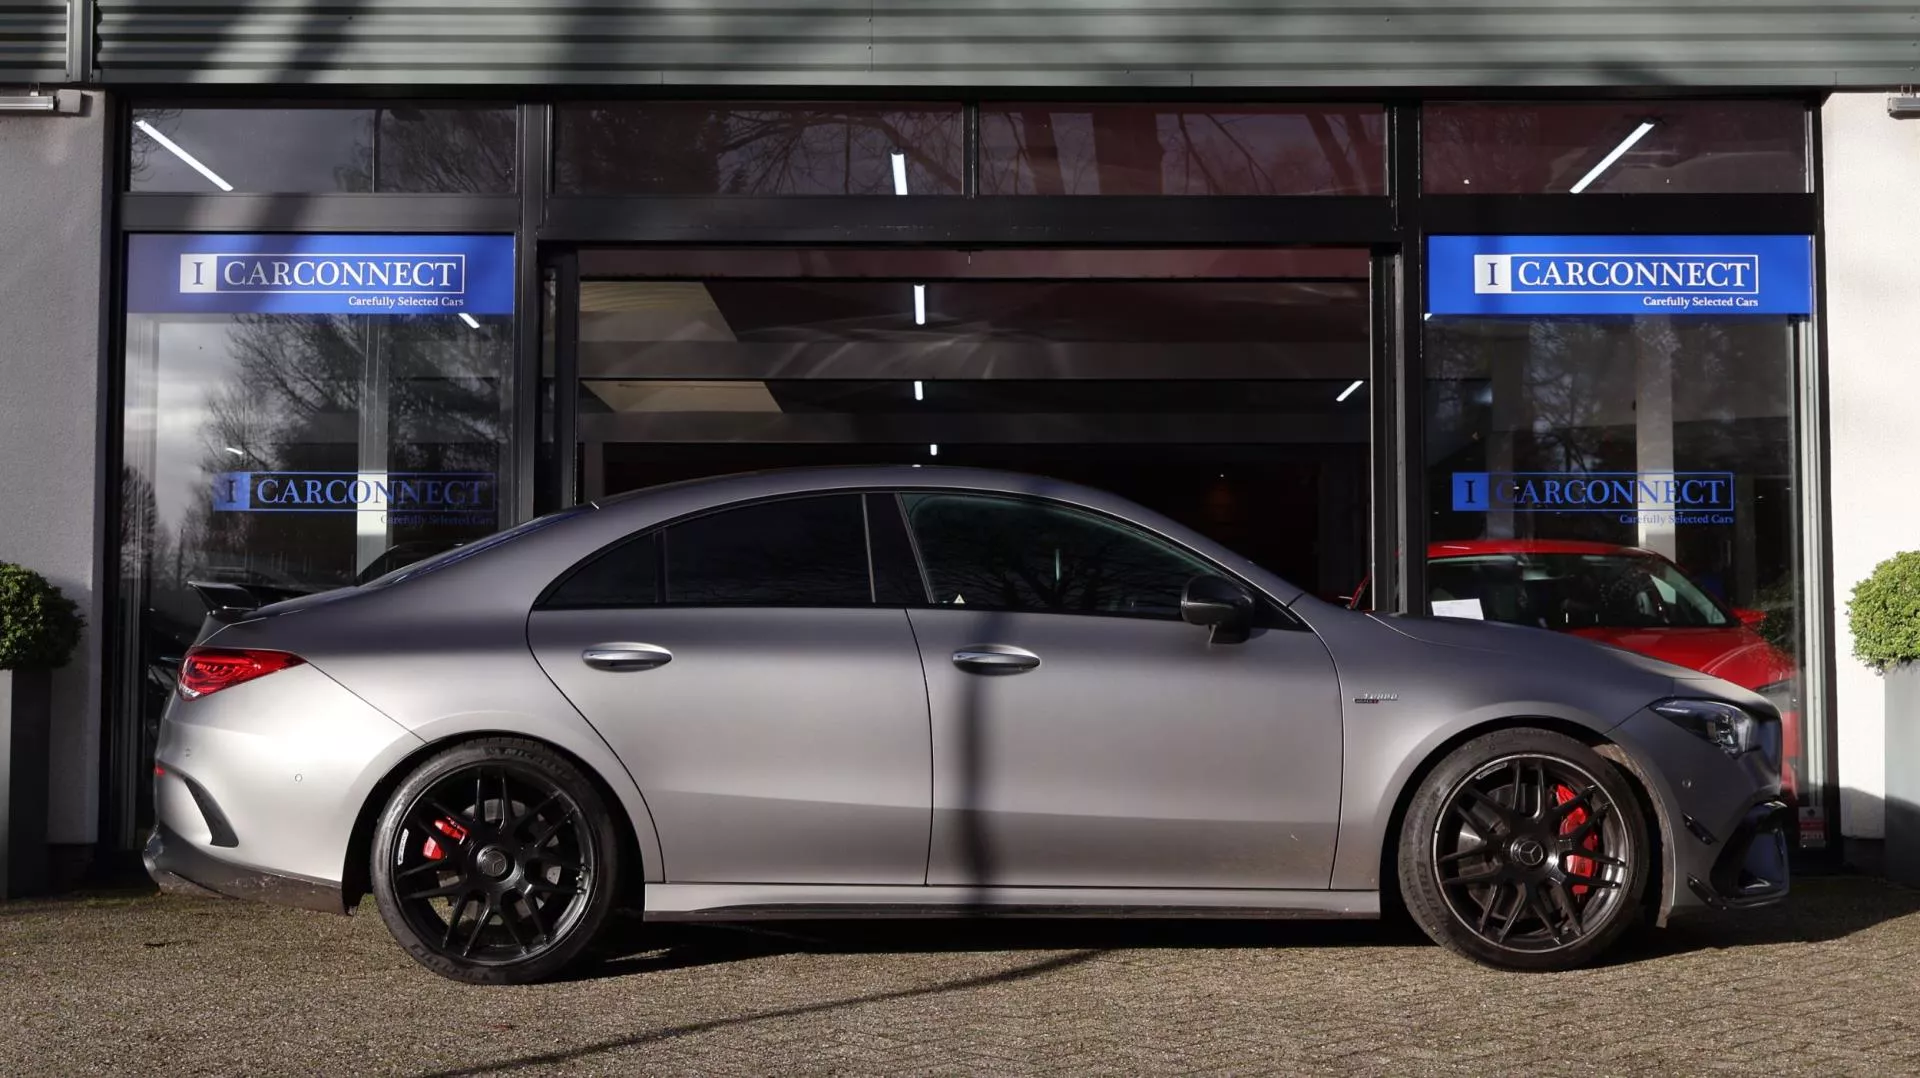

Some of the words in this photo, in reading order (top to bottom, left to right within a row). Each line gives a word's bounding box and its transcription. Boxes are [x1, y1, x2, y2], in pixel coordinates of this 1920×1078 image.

[193, 261, 203, 285] I
[224, 261, 457, 287] CARCONNECT
[1488, 262, 1498, 286] I
[1517, 261, 1750, 287] CARCONNECT
[348, 296, 396, 309] Carefully
[397, 296, 439, 307] Selected
[441, 296, 464, 307] Cars
[1643, 296, 1690, 309] Carefully
[1692, 296, 1733, 307] Selected
[1735, 297, 1759, 307] Cars
[257, 478, 487, 505] CARCONNECT
[1496, 479, 1725, 505] CARCONNECT
[380, 514, 427, 528] Carefully
[1620, 513, 1666, 526] Carefully
[1667, 513, 1709, 524] Selected
[1711, 514, 1734, 524] Cars
